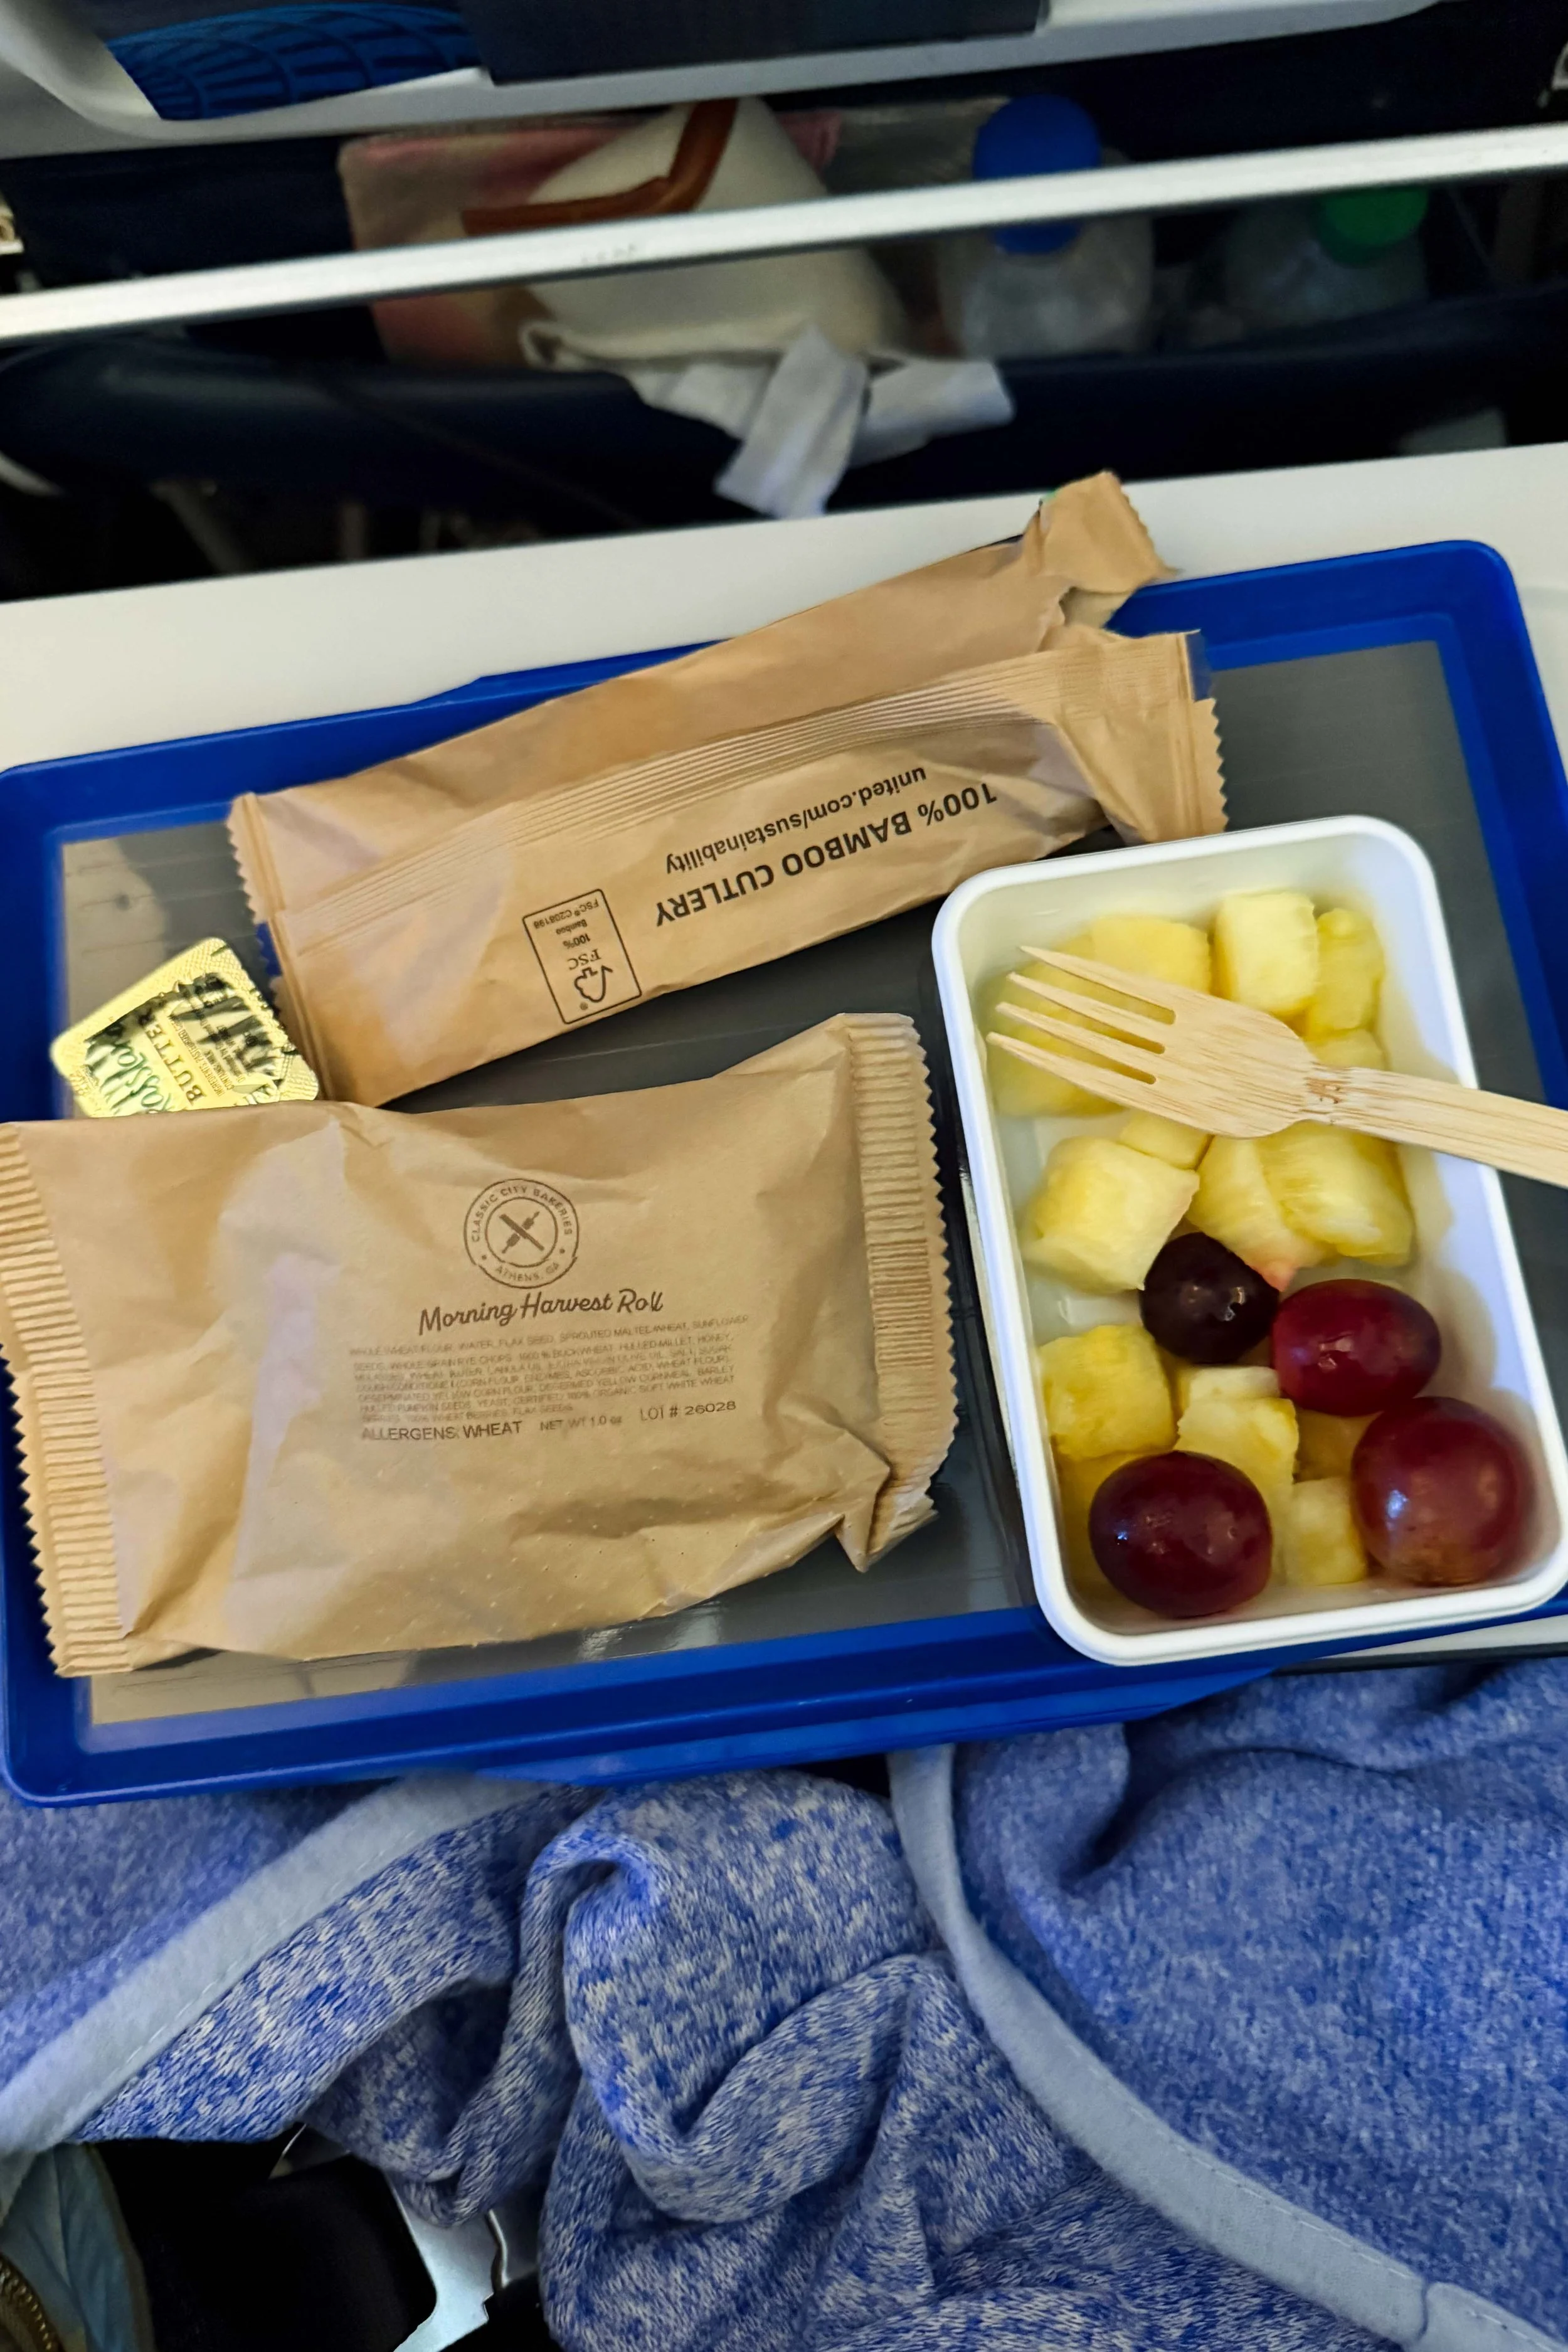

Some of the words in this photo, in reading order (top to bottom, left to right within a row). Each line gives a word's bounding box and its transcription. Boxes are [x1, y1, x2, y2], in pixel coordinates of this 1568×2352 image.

[666, 767, 926, 875] united.com/sustainability
[917, 782, 997, 826] 100%
[781, 811, 912, 876] BAMBOO
[655, 864, 775, 927] CUTLERY
[556, 919, 587, 935] Bamboo
[563, 933, 591, 949] 100%
[567, 948, 601, 970] FSC
[472, 1194, 498, 1242] CLASSIC
[500, 1186, 527, 1197] CITY
[534, 1189, 572, 1234] BAKERIES
[418, 1302, 516, 1336] Morning
[520, 1291, 613, 1320] Harvest
[617, 1288, 664, 1314] Roll
[667, 1378, 698, 1391] WHITE
[699, 1375, 735, 1387] WHEAT
[463, 1421, 522, 1439] WHEAT
[539, 1419, 564, 1431] NET
[568, 1416, 586, 1429] WT
[640, 1405, 665, 1422] LOT
[669, 1406, 679, 1418] #
[684, 1401, 737, 1416] 26028
